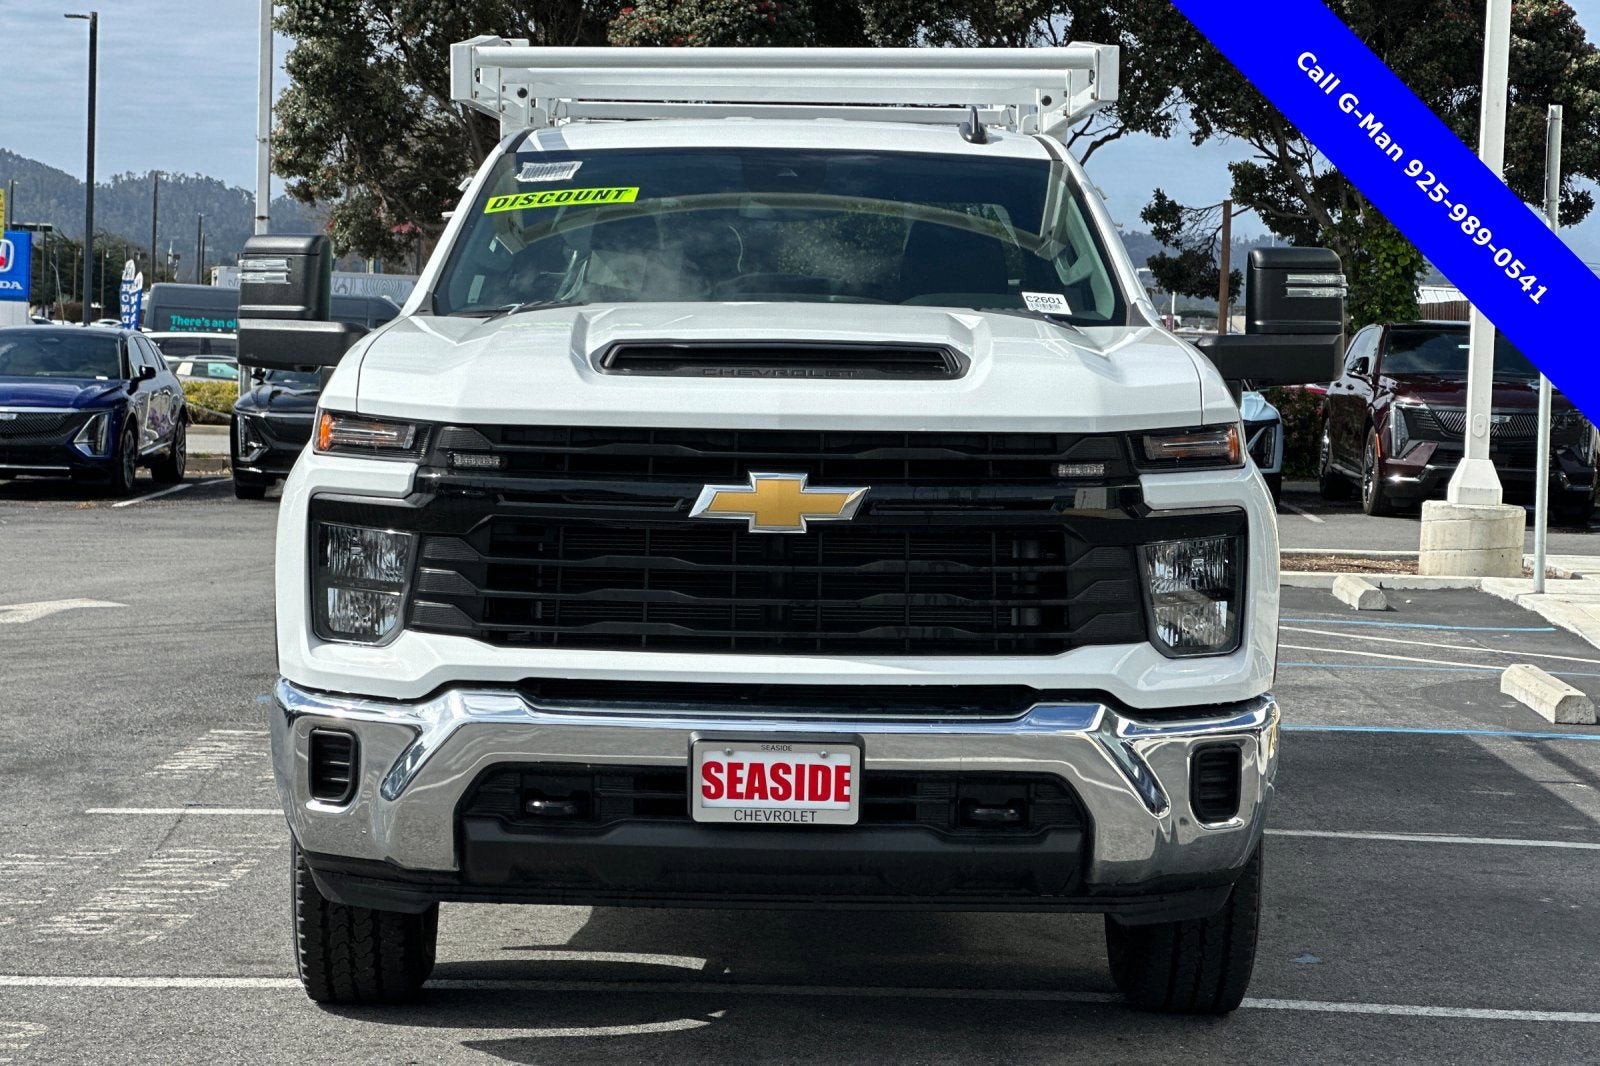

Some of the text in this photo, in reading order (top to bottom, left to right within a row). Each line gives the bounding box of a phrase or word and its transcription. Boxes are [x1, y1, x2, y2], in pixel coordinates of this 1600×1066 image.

[490, 189, 629, 209] DISCOUNT
[1025, 295, 1063, 305] C2601
[170, 314, 210, 327] There's
[212, 319, 225, 328] an
[702, 368, 859, 378] CHEVROLET
[760, 744, 793, 752] SEASIDE
[701, 761, 851, 803] SEASIDE
[734, 809, 817, 823] CHEVROLET
